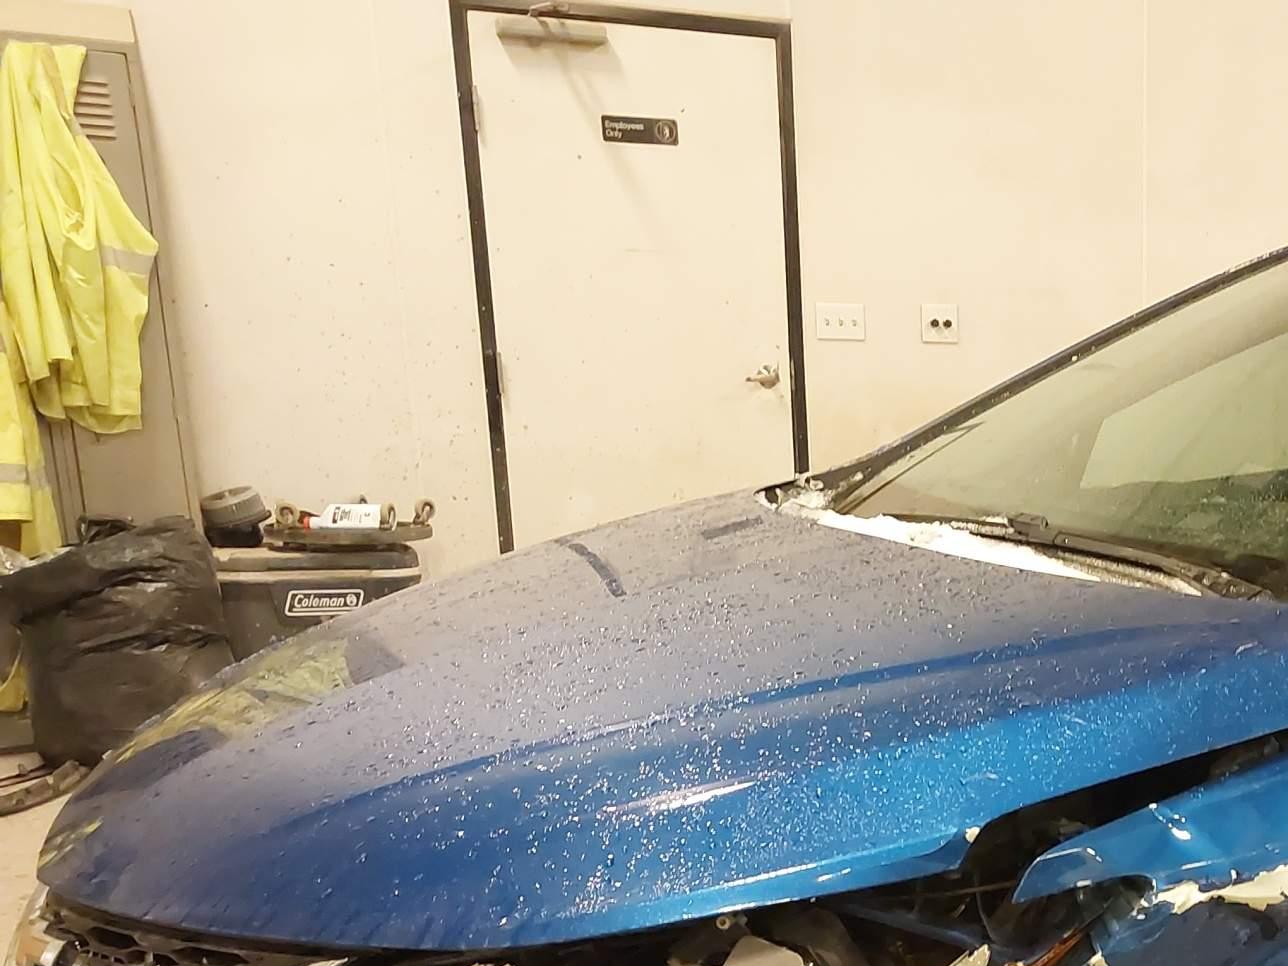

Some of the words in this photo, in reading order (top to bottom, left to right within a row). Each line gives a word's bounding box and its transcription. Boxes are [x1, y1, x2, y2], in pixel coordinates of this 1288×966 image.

[605, 120, 644, 130] Employees
[605, 128, 622, 139] Only
[294, 594, 345, 608] Coleman
